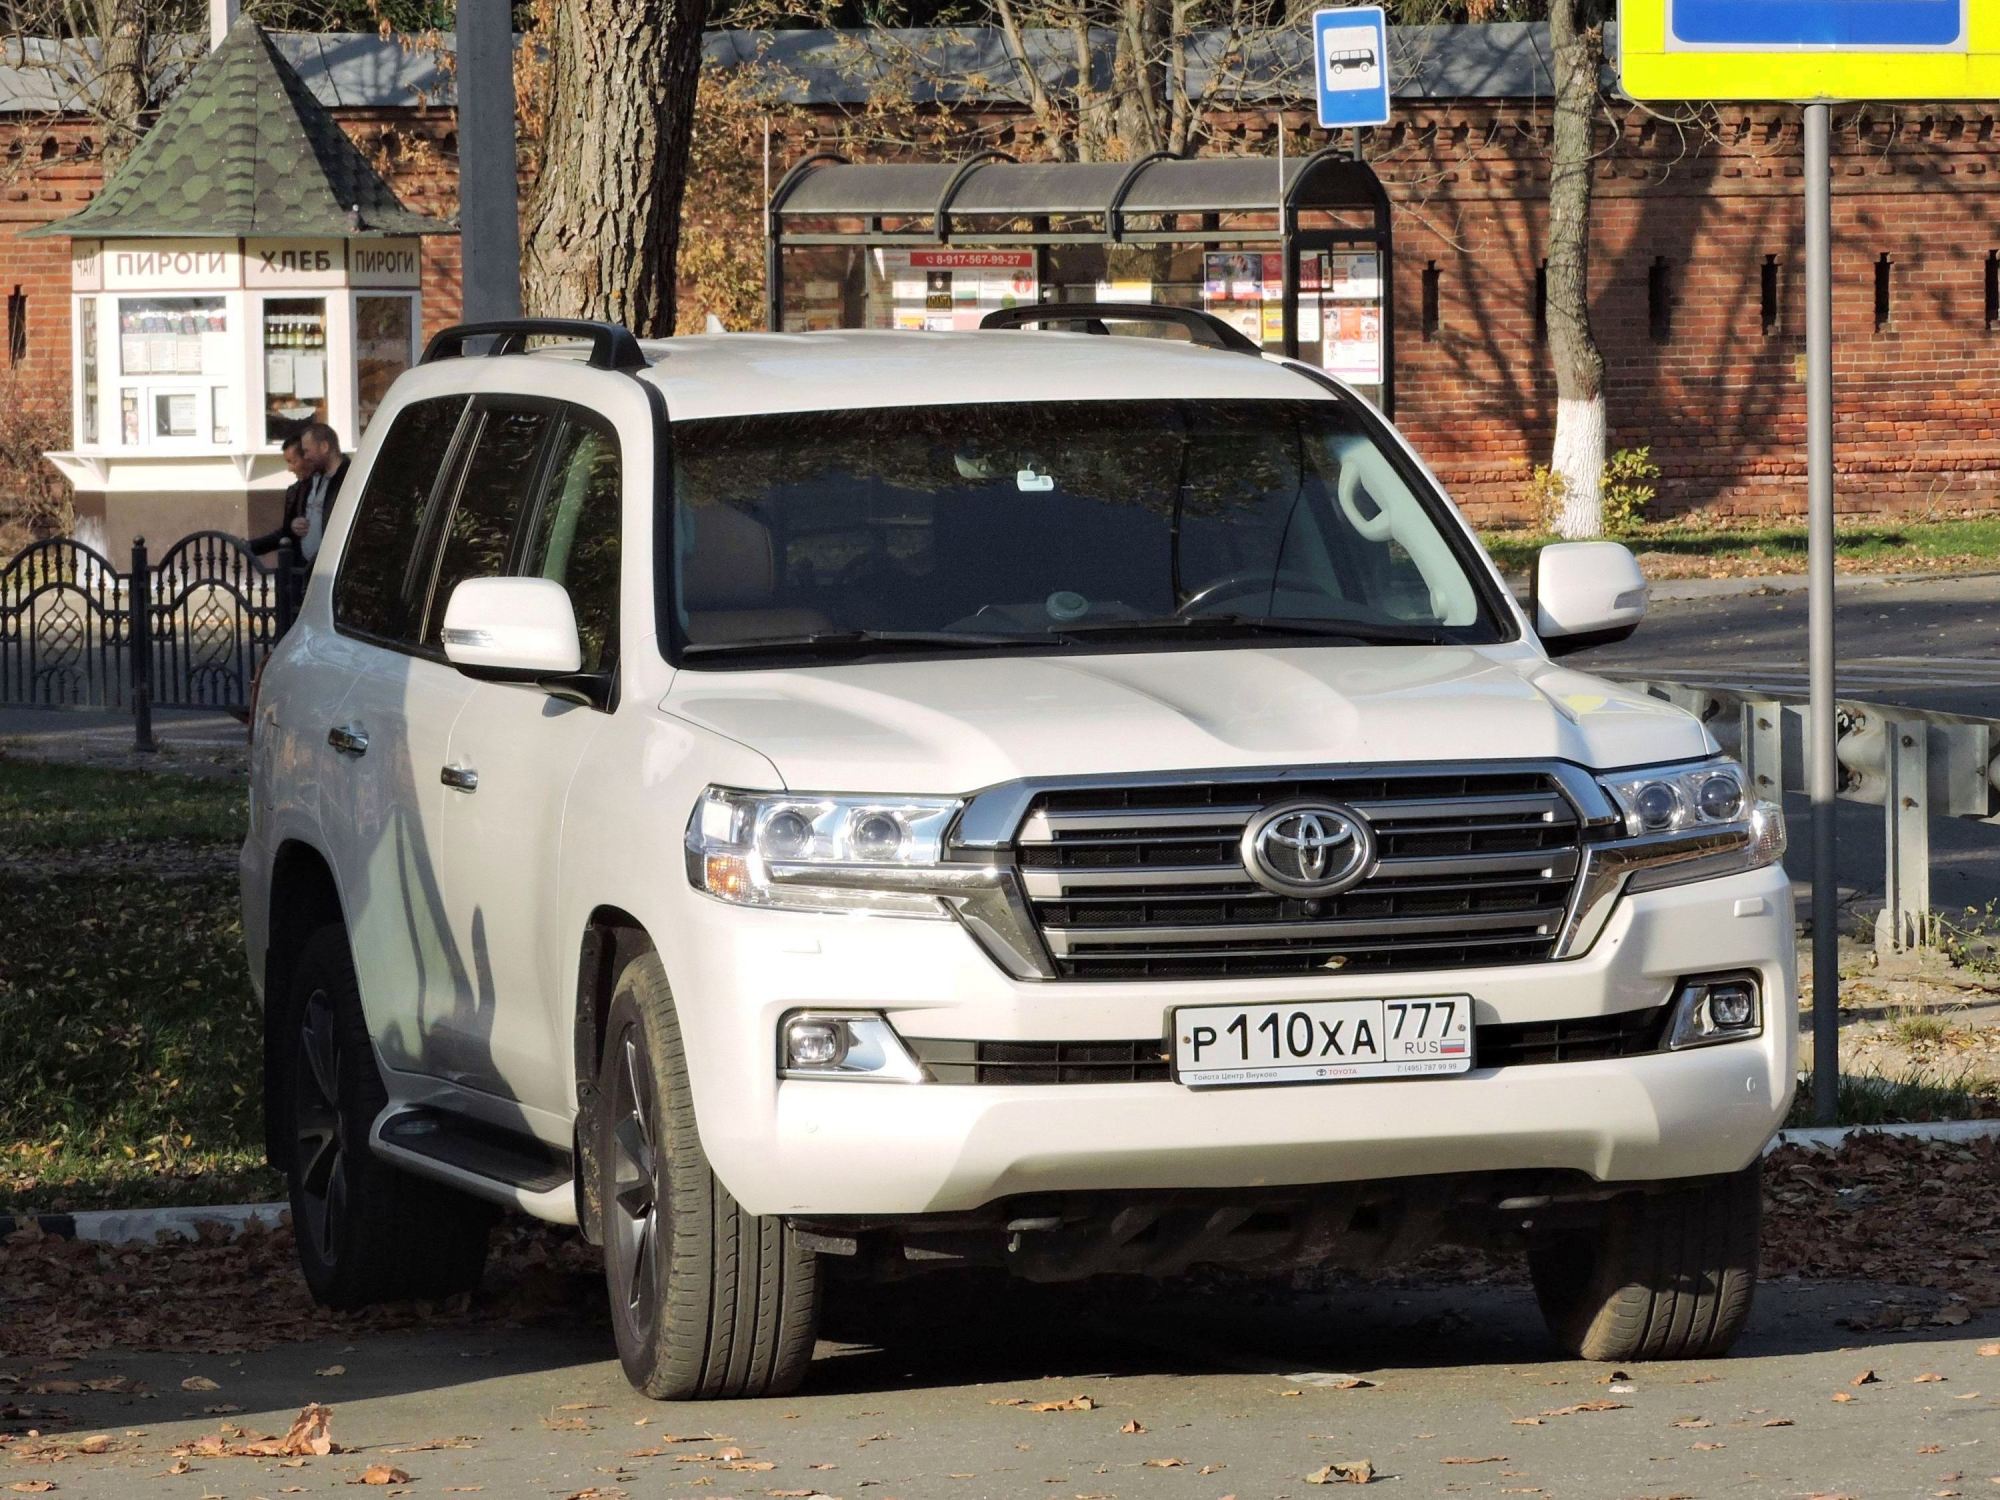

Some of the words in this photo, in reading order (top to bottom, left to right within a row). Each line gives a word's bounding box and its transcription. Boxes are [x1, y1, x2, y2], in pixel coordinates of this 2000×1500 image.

[75, 247, 96, 278] ЧАЙ
[116, 251, 227, 276] ПИРОГИ
[260, 250, 331, 273] ХЛЕБ
[355, 250, 414, 275] ПИРОГИ
[936, 255, 1021, 265] 8-917-567-99-27
[1387, 1001, 1456, 1041] 777
[1404, 1040, 1439, 1054] RUS
[1221, 1072, 1245, 1080] Центр
